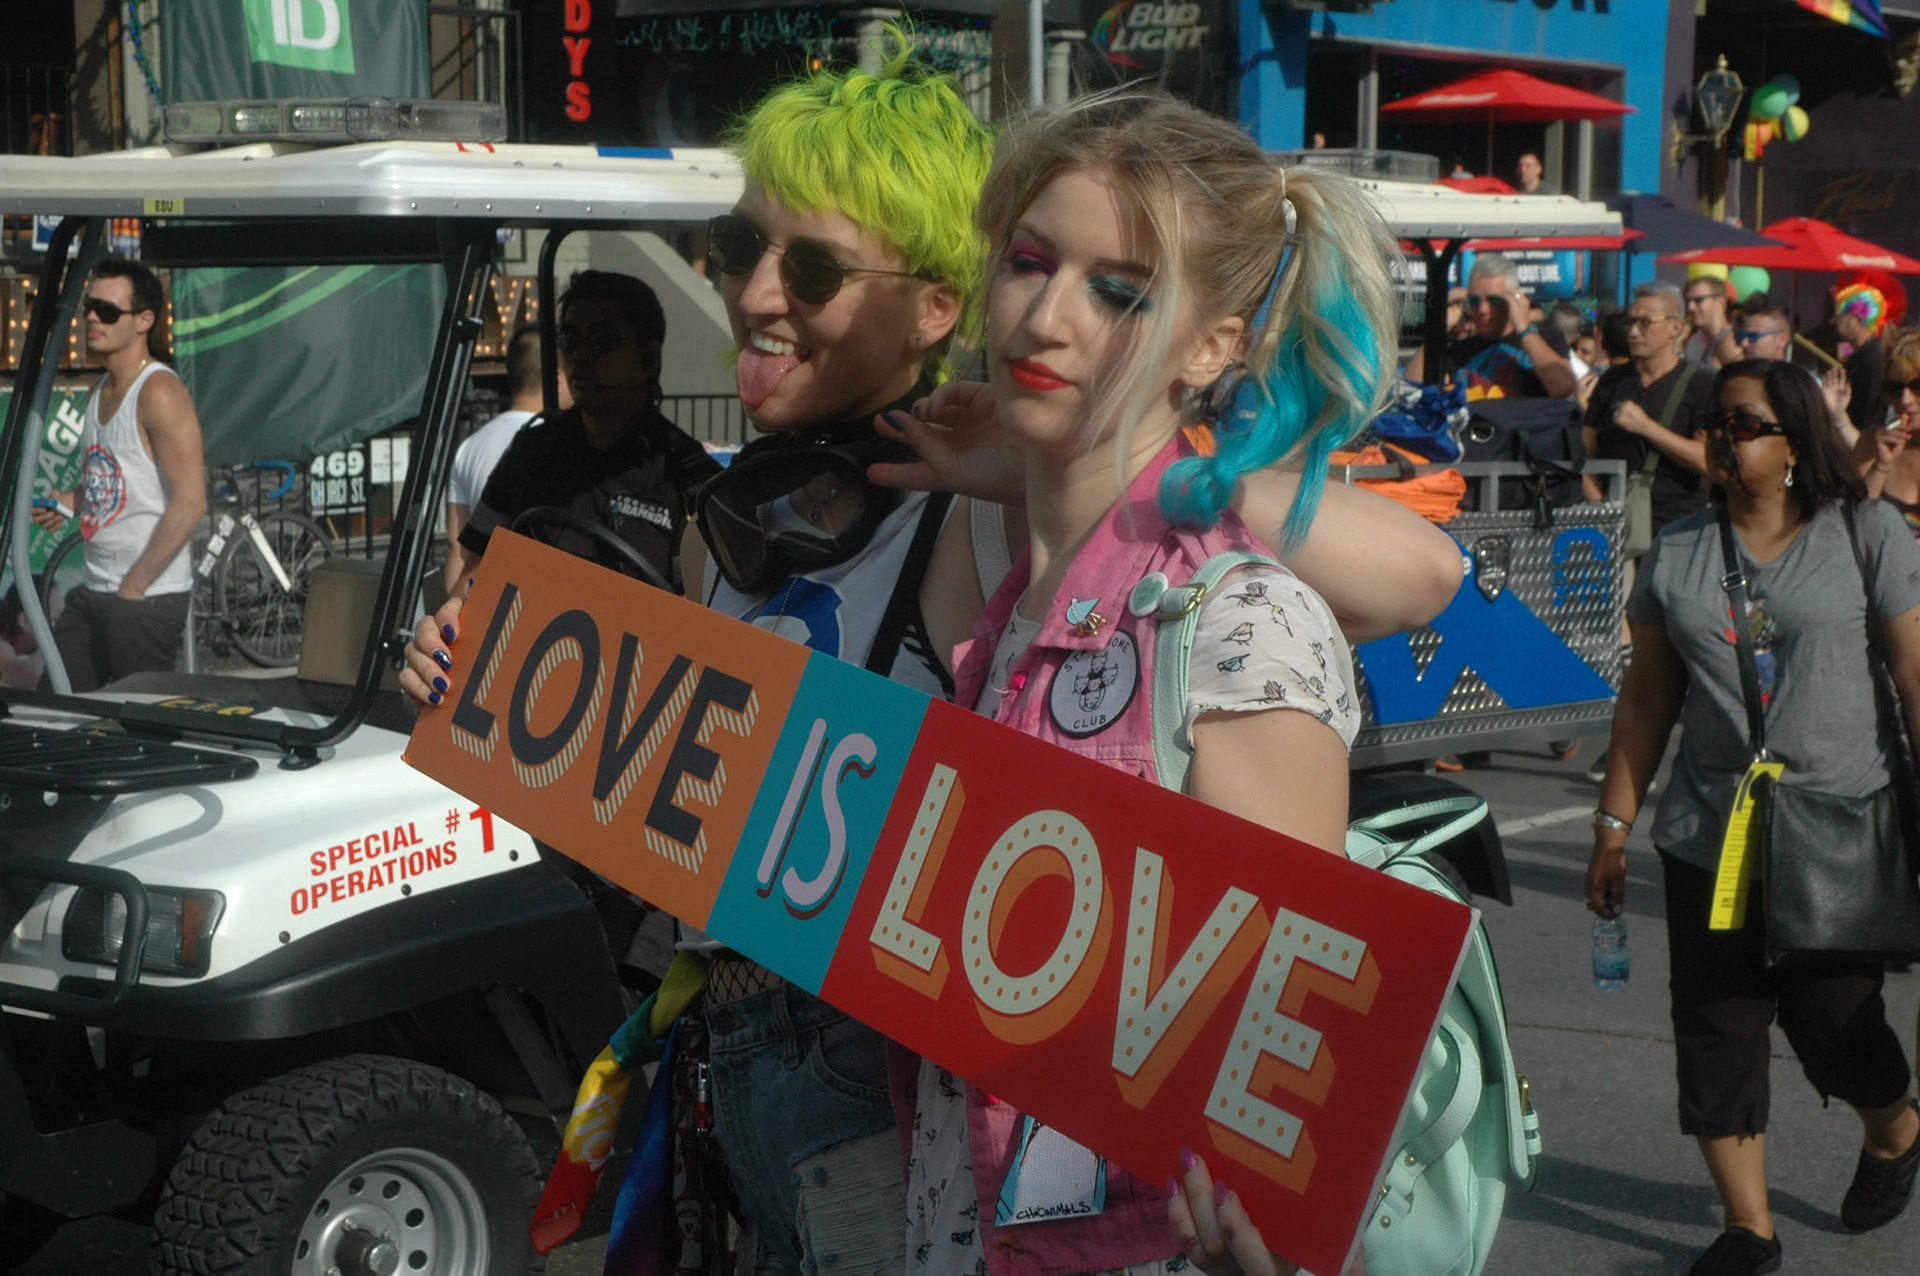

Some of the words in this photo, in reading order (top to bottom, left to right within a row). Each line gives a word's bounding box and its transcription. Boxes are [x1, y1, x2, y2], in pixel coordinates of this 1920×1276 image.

[1126, 2, 1201, 27] BUD
[1109, 25, 1211, 52] LIGHT
[154, 200, 174, 212] ESU
[310, 449, 365, 478] 469
[1073, 714, 1107, 730] CLUB
[310, 822, 423, 877] SPECIAL
[290, 840, 457, 916] OPERATIONS
[451, 582, 760, 874] LOVE
[756, 717, 878, 921] IS
[869, 762, 1381, 1196] LOVE
